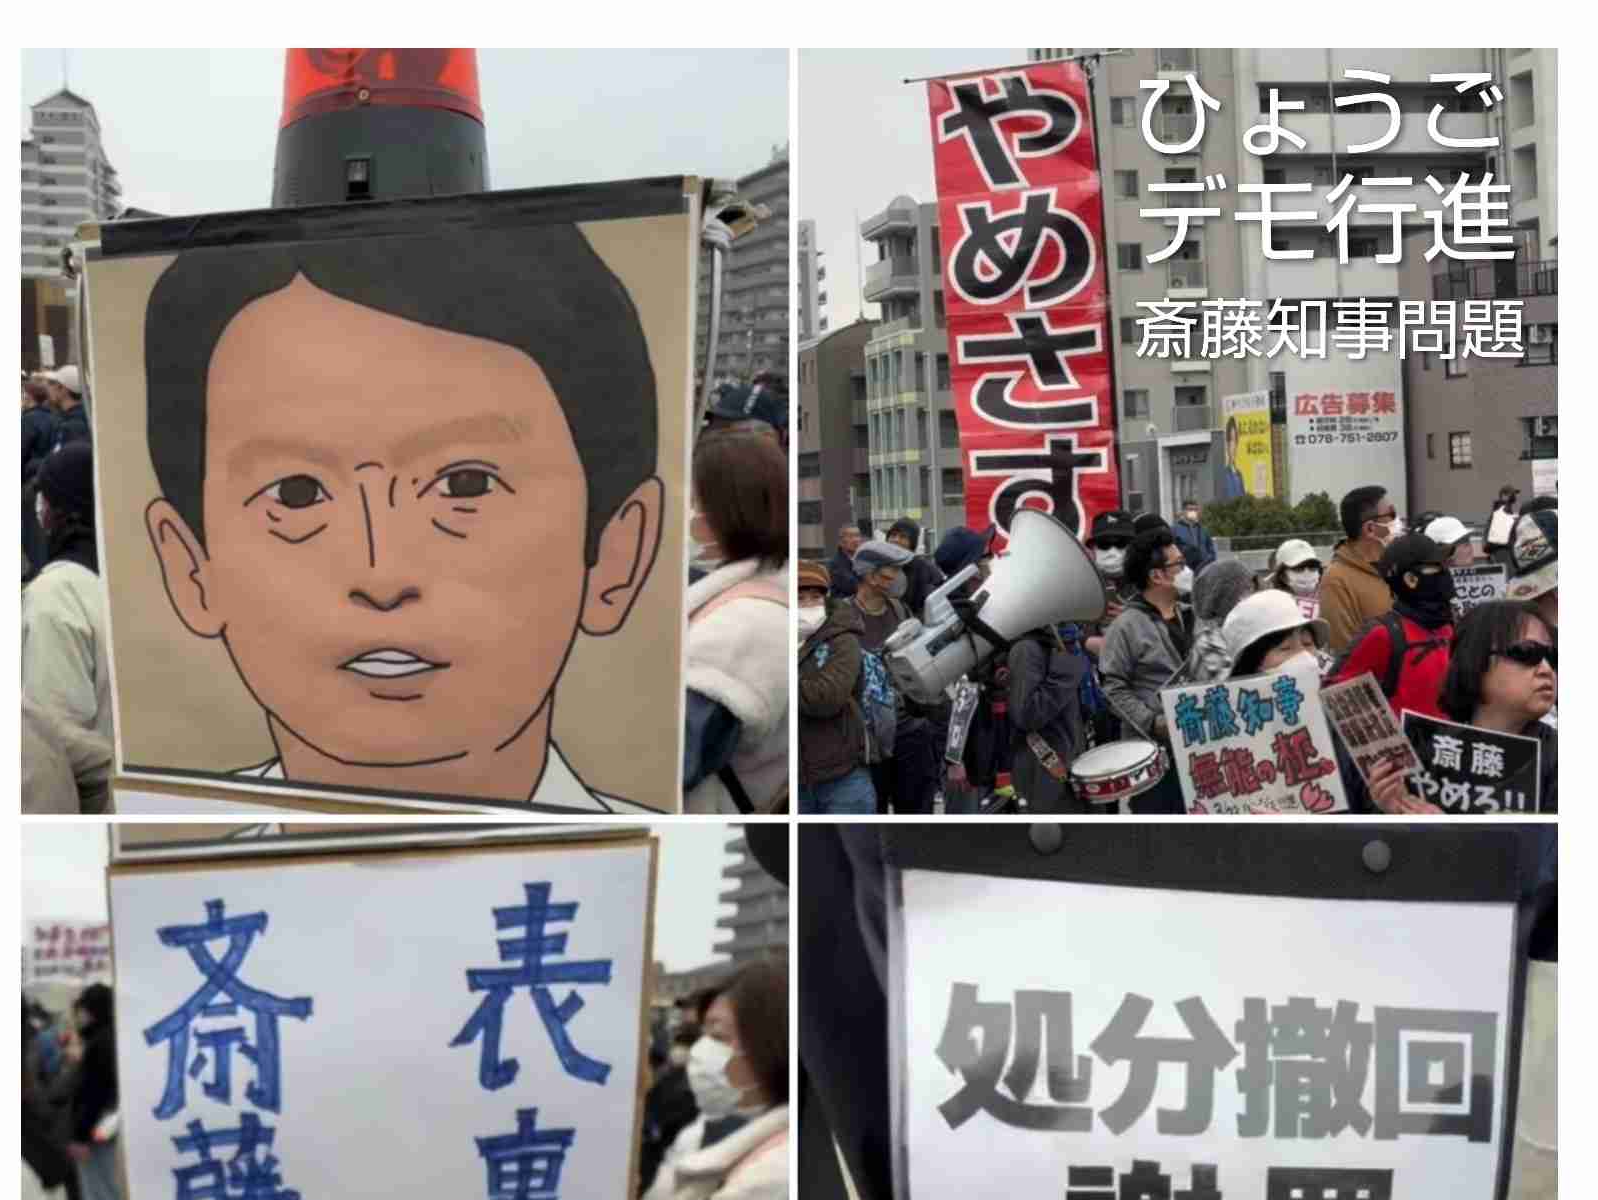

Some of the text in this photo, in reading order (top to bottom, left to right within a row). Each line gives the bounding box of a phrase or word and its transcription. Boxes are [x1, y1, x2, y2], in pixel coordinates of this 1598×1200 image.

[938, 67, 1109, 546] やめさす
[1296, 391, 1396, 416] 広告募集
[1432, 735, 1505, 777] 斎藤
[935, 981, 1499, 1144] 処分撤回
